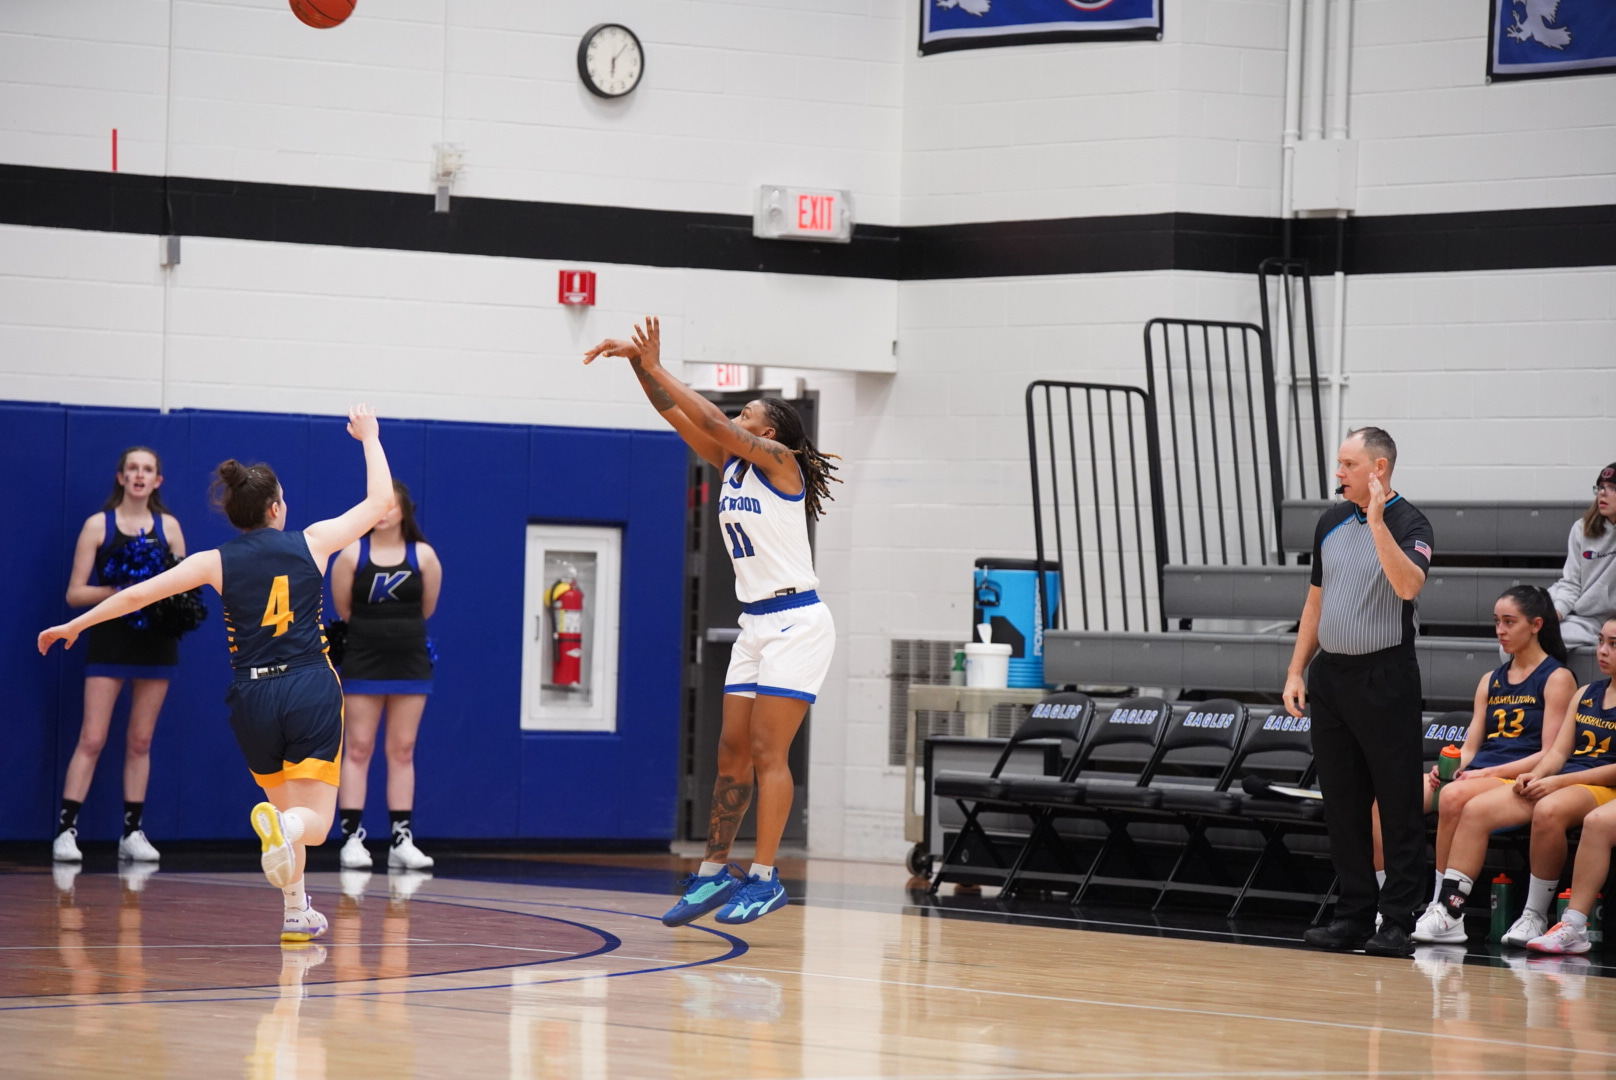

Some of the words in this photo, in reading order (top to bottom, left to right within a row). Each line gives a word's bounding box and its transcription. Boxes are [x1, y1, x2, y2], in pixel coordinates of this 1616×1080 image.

[797, 194, 835, 231] EXIT
[725, 522, 755, 559] 11
[368, 571, 412, 603] K
[261, 575, 294, 637] 4
[1032, 703, 1082, 719] EAGLES
[1109, 708, 1158, 725] EAGLES
[1183, 712, 1235, 729] EAGLES
[1263, 715, 1312, 732] EAGLES
